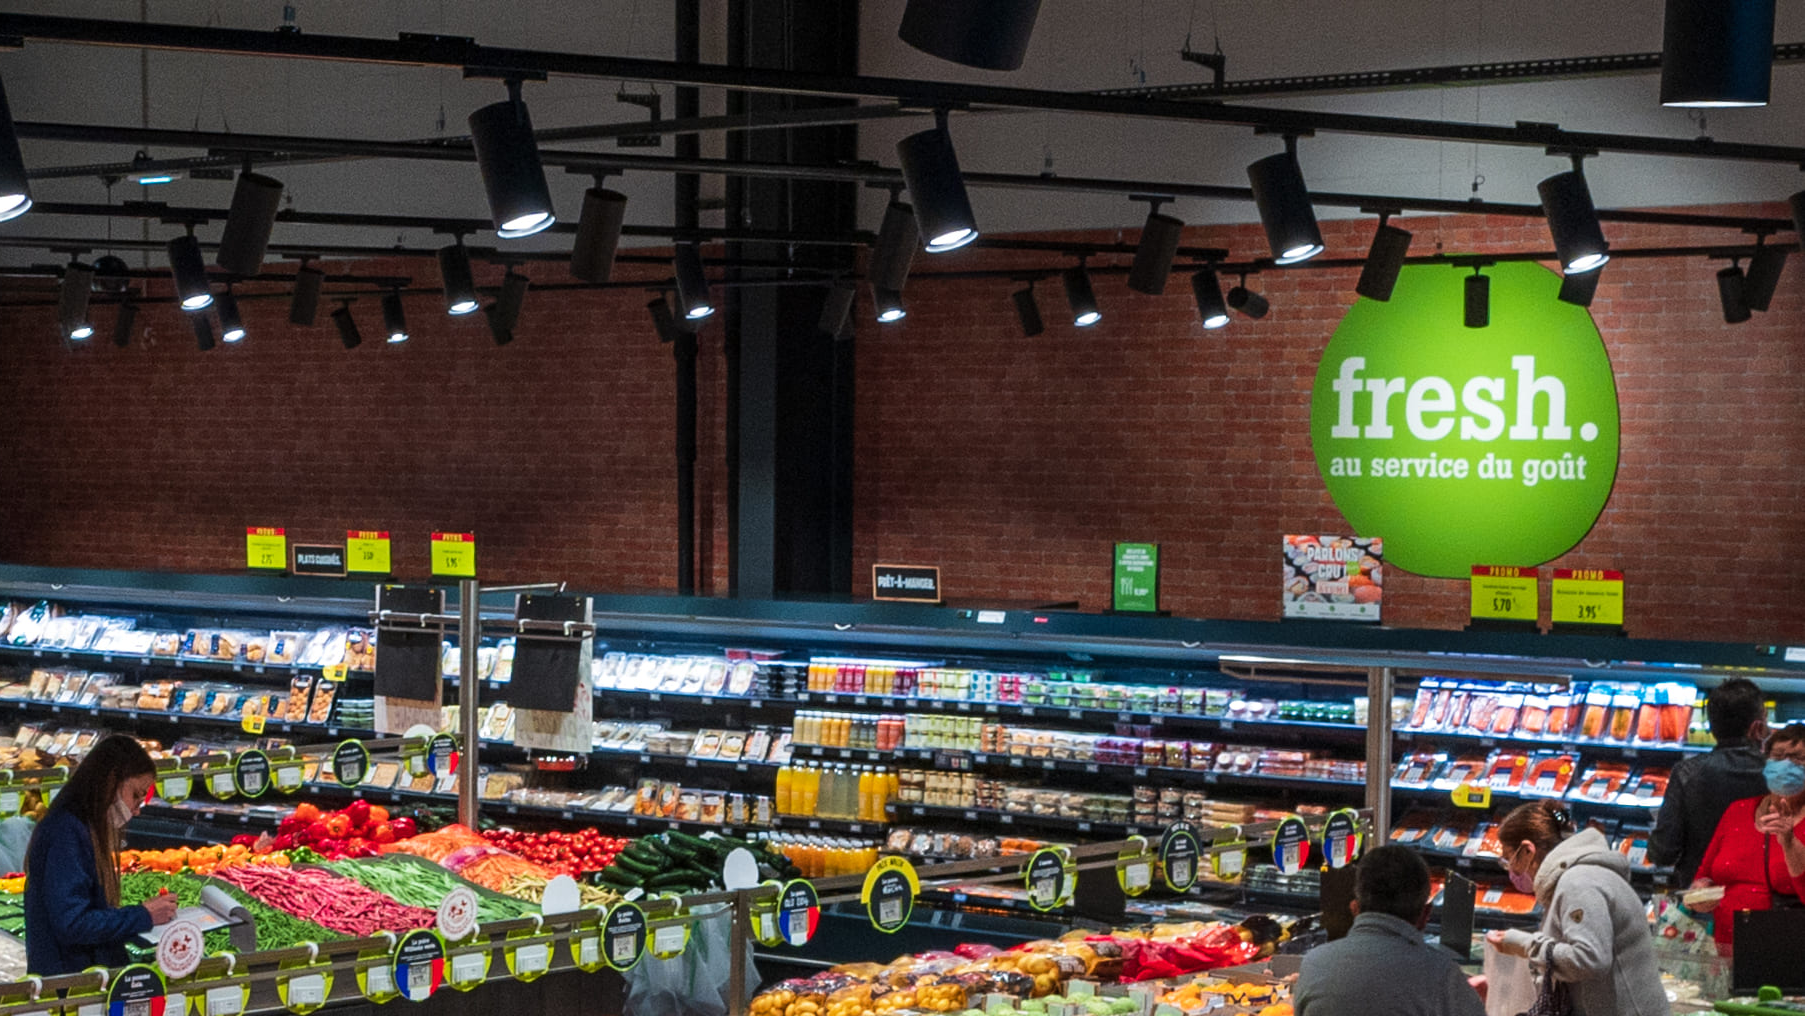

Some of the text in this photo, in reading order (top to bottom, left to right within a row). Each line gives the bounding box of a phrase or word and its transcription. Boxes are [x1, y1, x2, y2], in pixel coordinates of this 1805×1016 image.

[1331, 355, 1598, 442] fresh.
[1330, 452, 1587, 487] au service du goût
[1307, 546, 1358, 561] PARLONS
[1319, 564, 1340, 578] CRU
[1490, 566, 1520, 577] PROMO
[1572, 570, 1604, 580] PROMO
